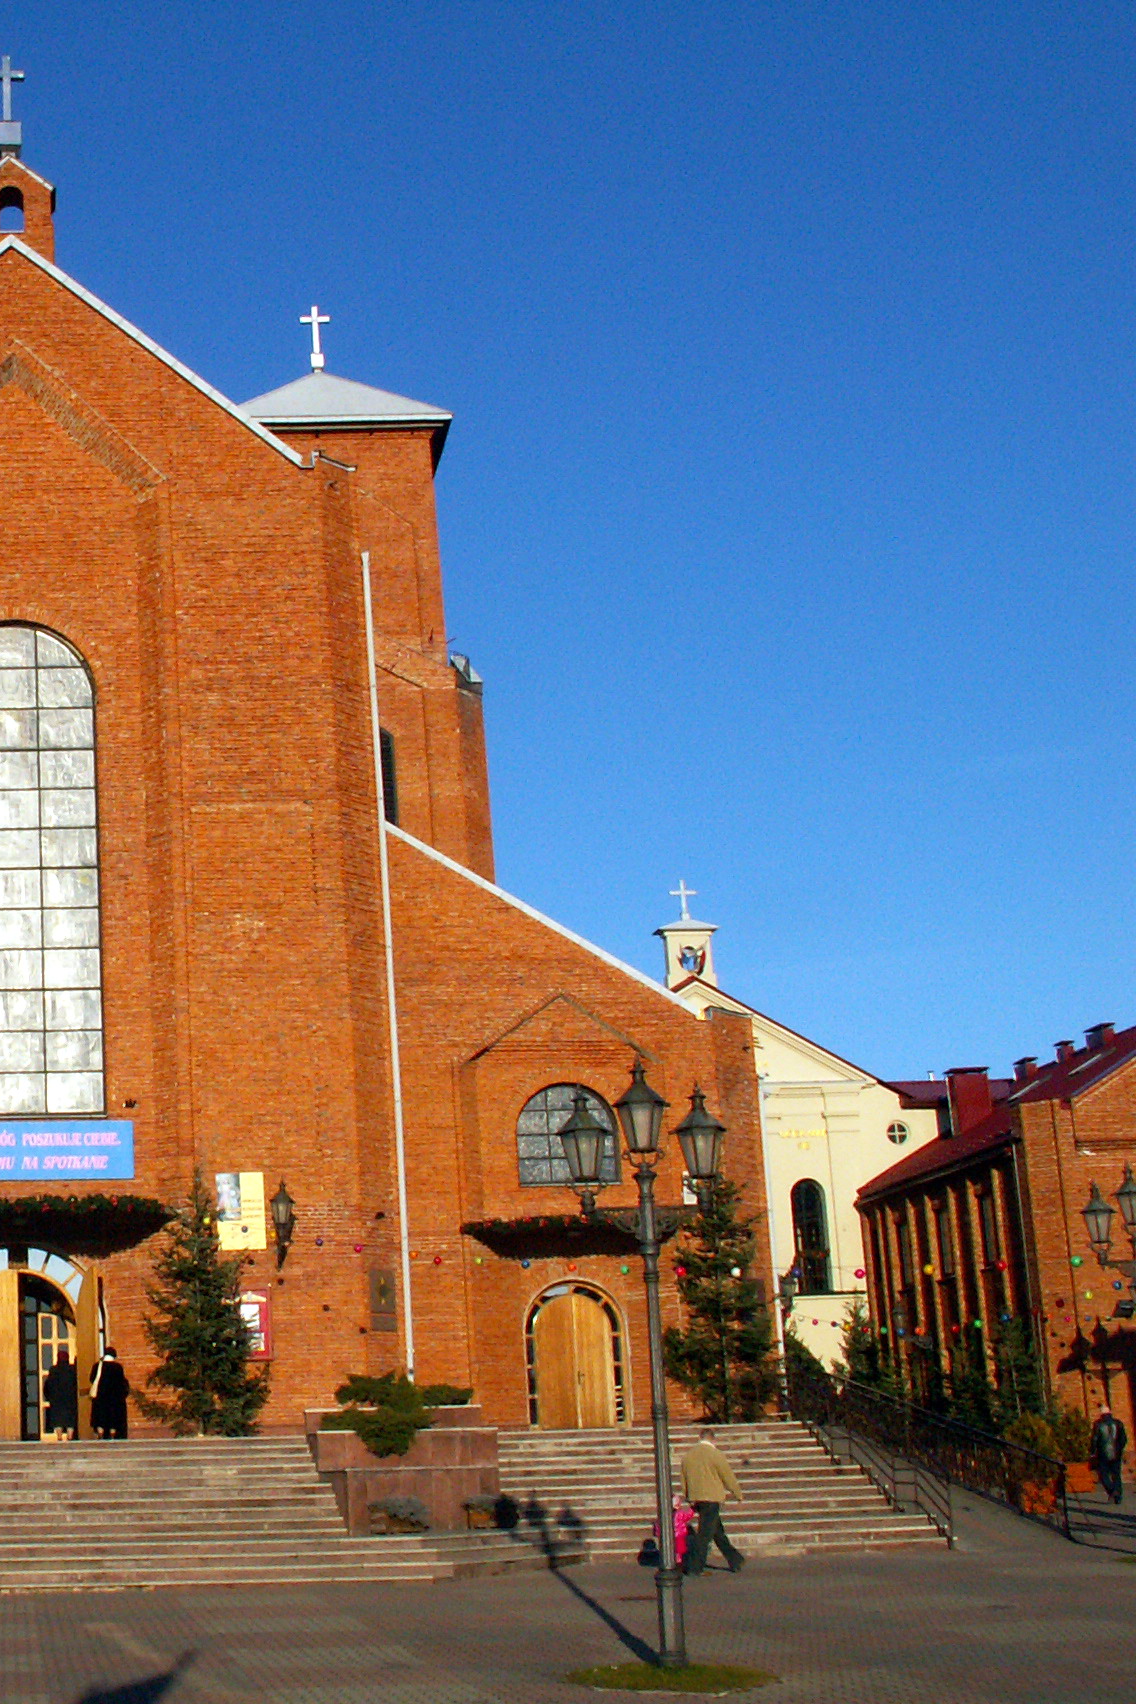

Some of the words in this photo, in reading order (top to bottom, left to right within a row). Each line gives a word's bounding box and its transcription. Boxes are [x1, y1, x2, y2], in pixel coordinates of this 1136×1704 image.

[22, 1132, 82, 1146] POSZUKUJE
[21, 1156, 39, 1170] NA
[43, 1155, 109, 1170] SPOTKANIE
